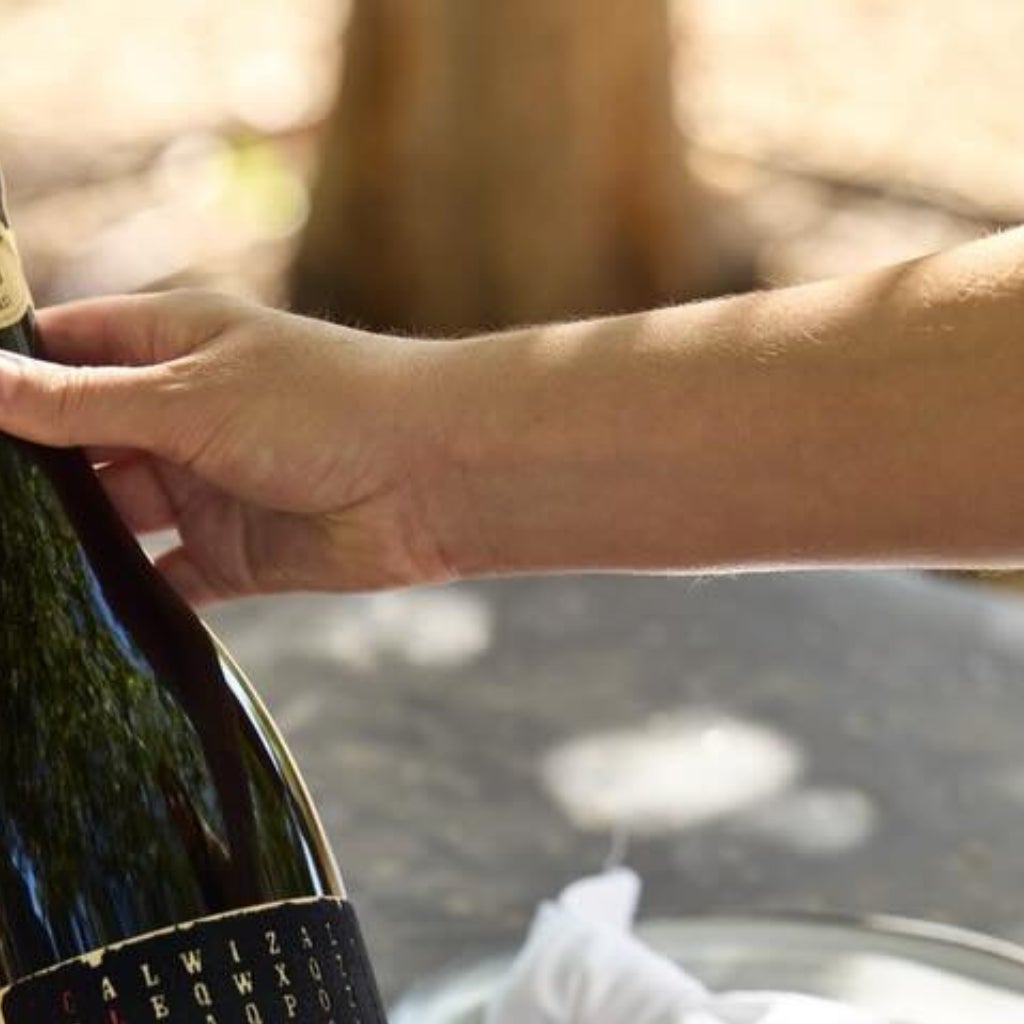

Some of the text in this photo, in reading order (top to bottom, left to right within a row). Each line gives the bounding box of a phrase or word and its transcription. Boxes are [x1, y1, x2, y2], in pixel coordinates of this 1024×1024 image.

[102, 976, 117, 1002] A
[140, 963, 159, 987] L
[179, 949, 202, 975] W
[233, 970, 253, 996] W
[274, 962, 291, 987] X
[283, 993, 297, 1018] P
